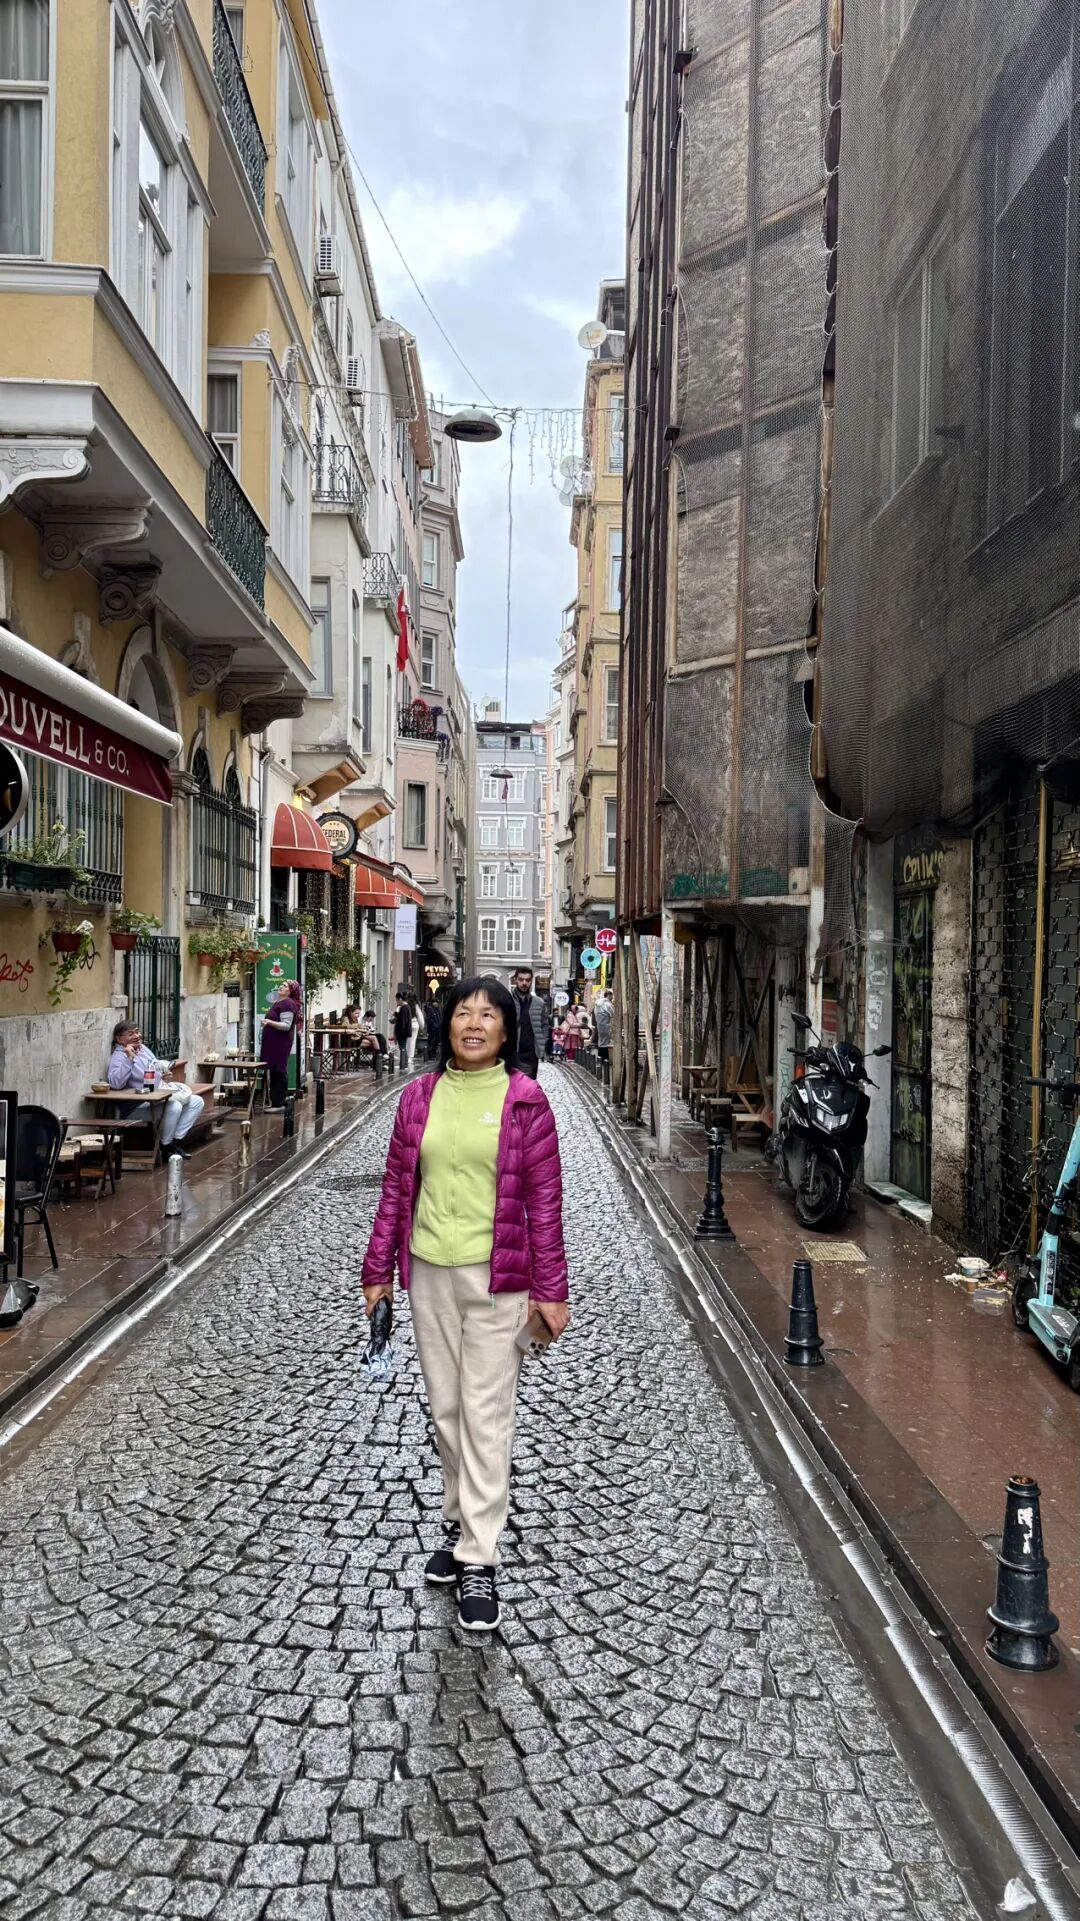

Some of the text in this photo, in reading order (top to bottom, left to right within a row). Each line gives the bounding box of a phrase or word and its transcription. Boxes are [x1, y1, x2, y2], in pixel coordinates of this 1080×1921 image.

[94, 739, 104, 764] &
[107, 745, 129, 776] CO.
[424, 965, 450, 973] PEYRA
